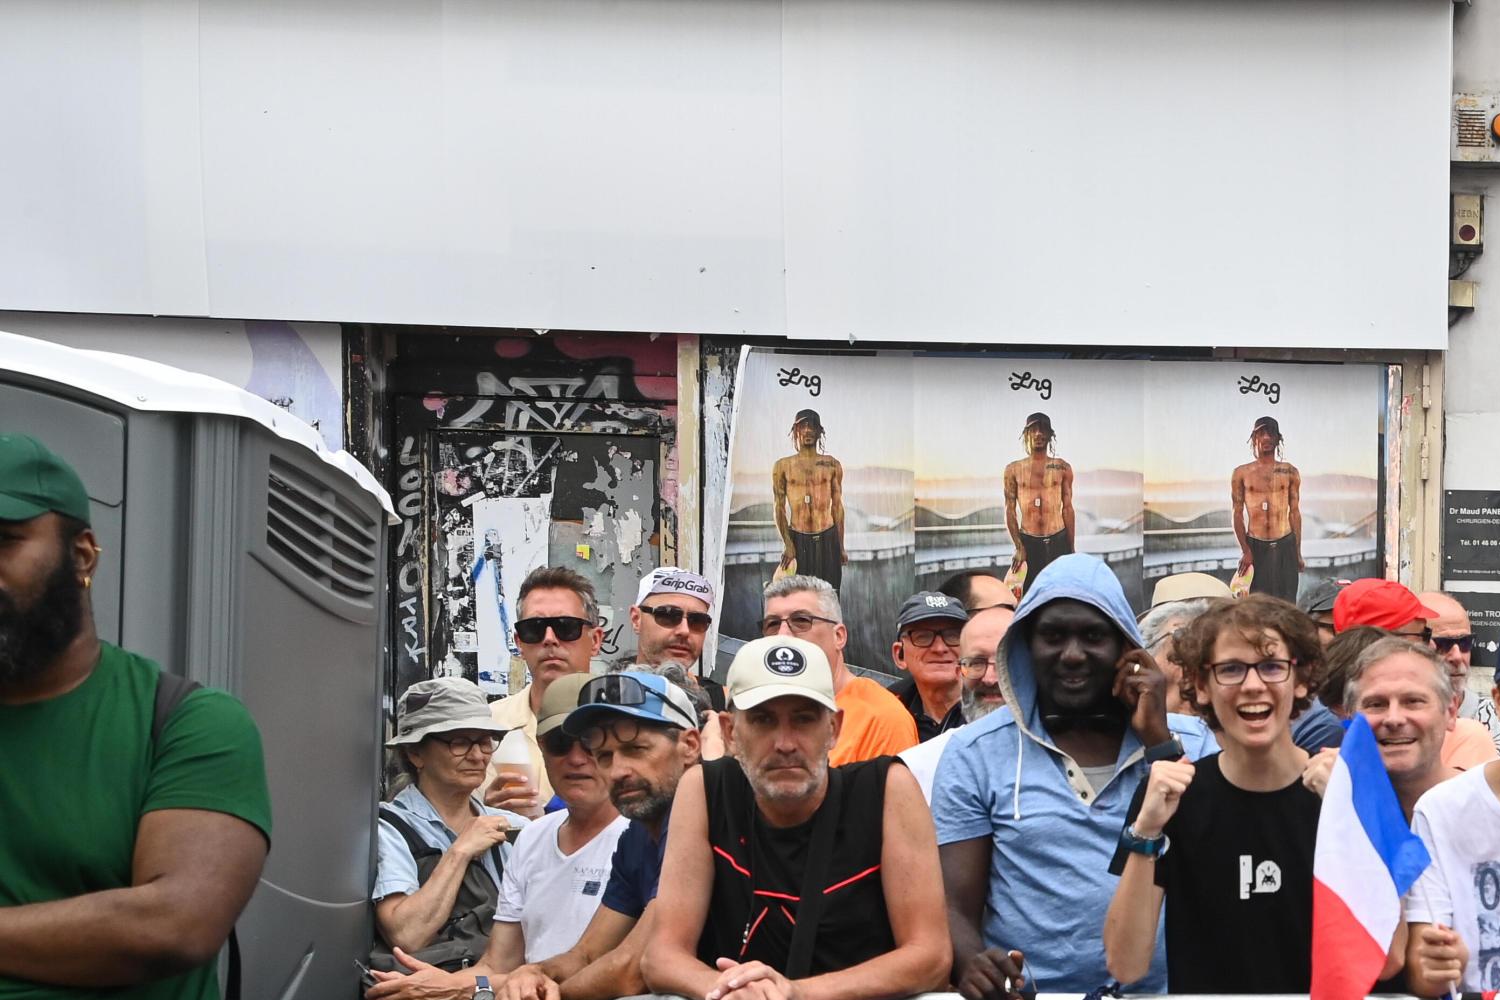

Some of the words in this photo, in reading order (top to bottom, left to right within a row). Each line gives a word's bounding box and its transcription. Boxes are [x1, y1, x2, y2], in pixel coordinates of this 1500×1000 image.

[1449, 507, 1458, 515] Dr
[1460, 507, 1480, 515] Maud
[661, 577, 709, 594] GripGrab
[1467, 610, 1484, 618] rien
